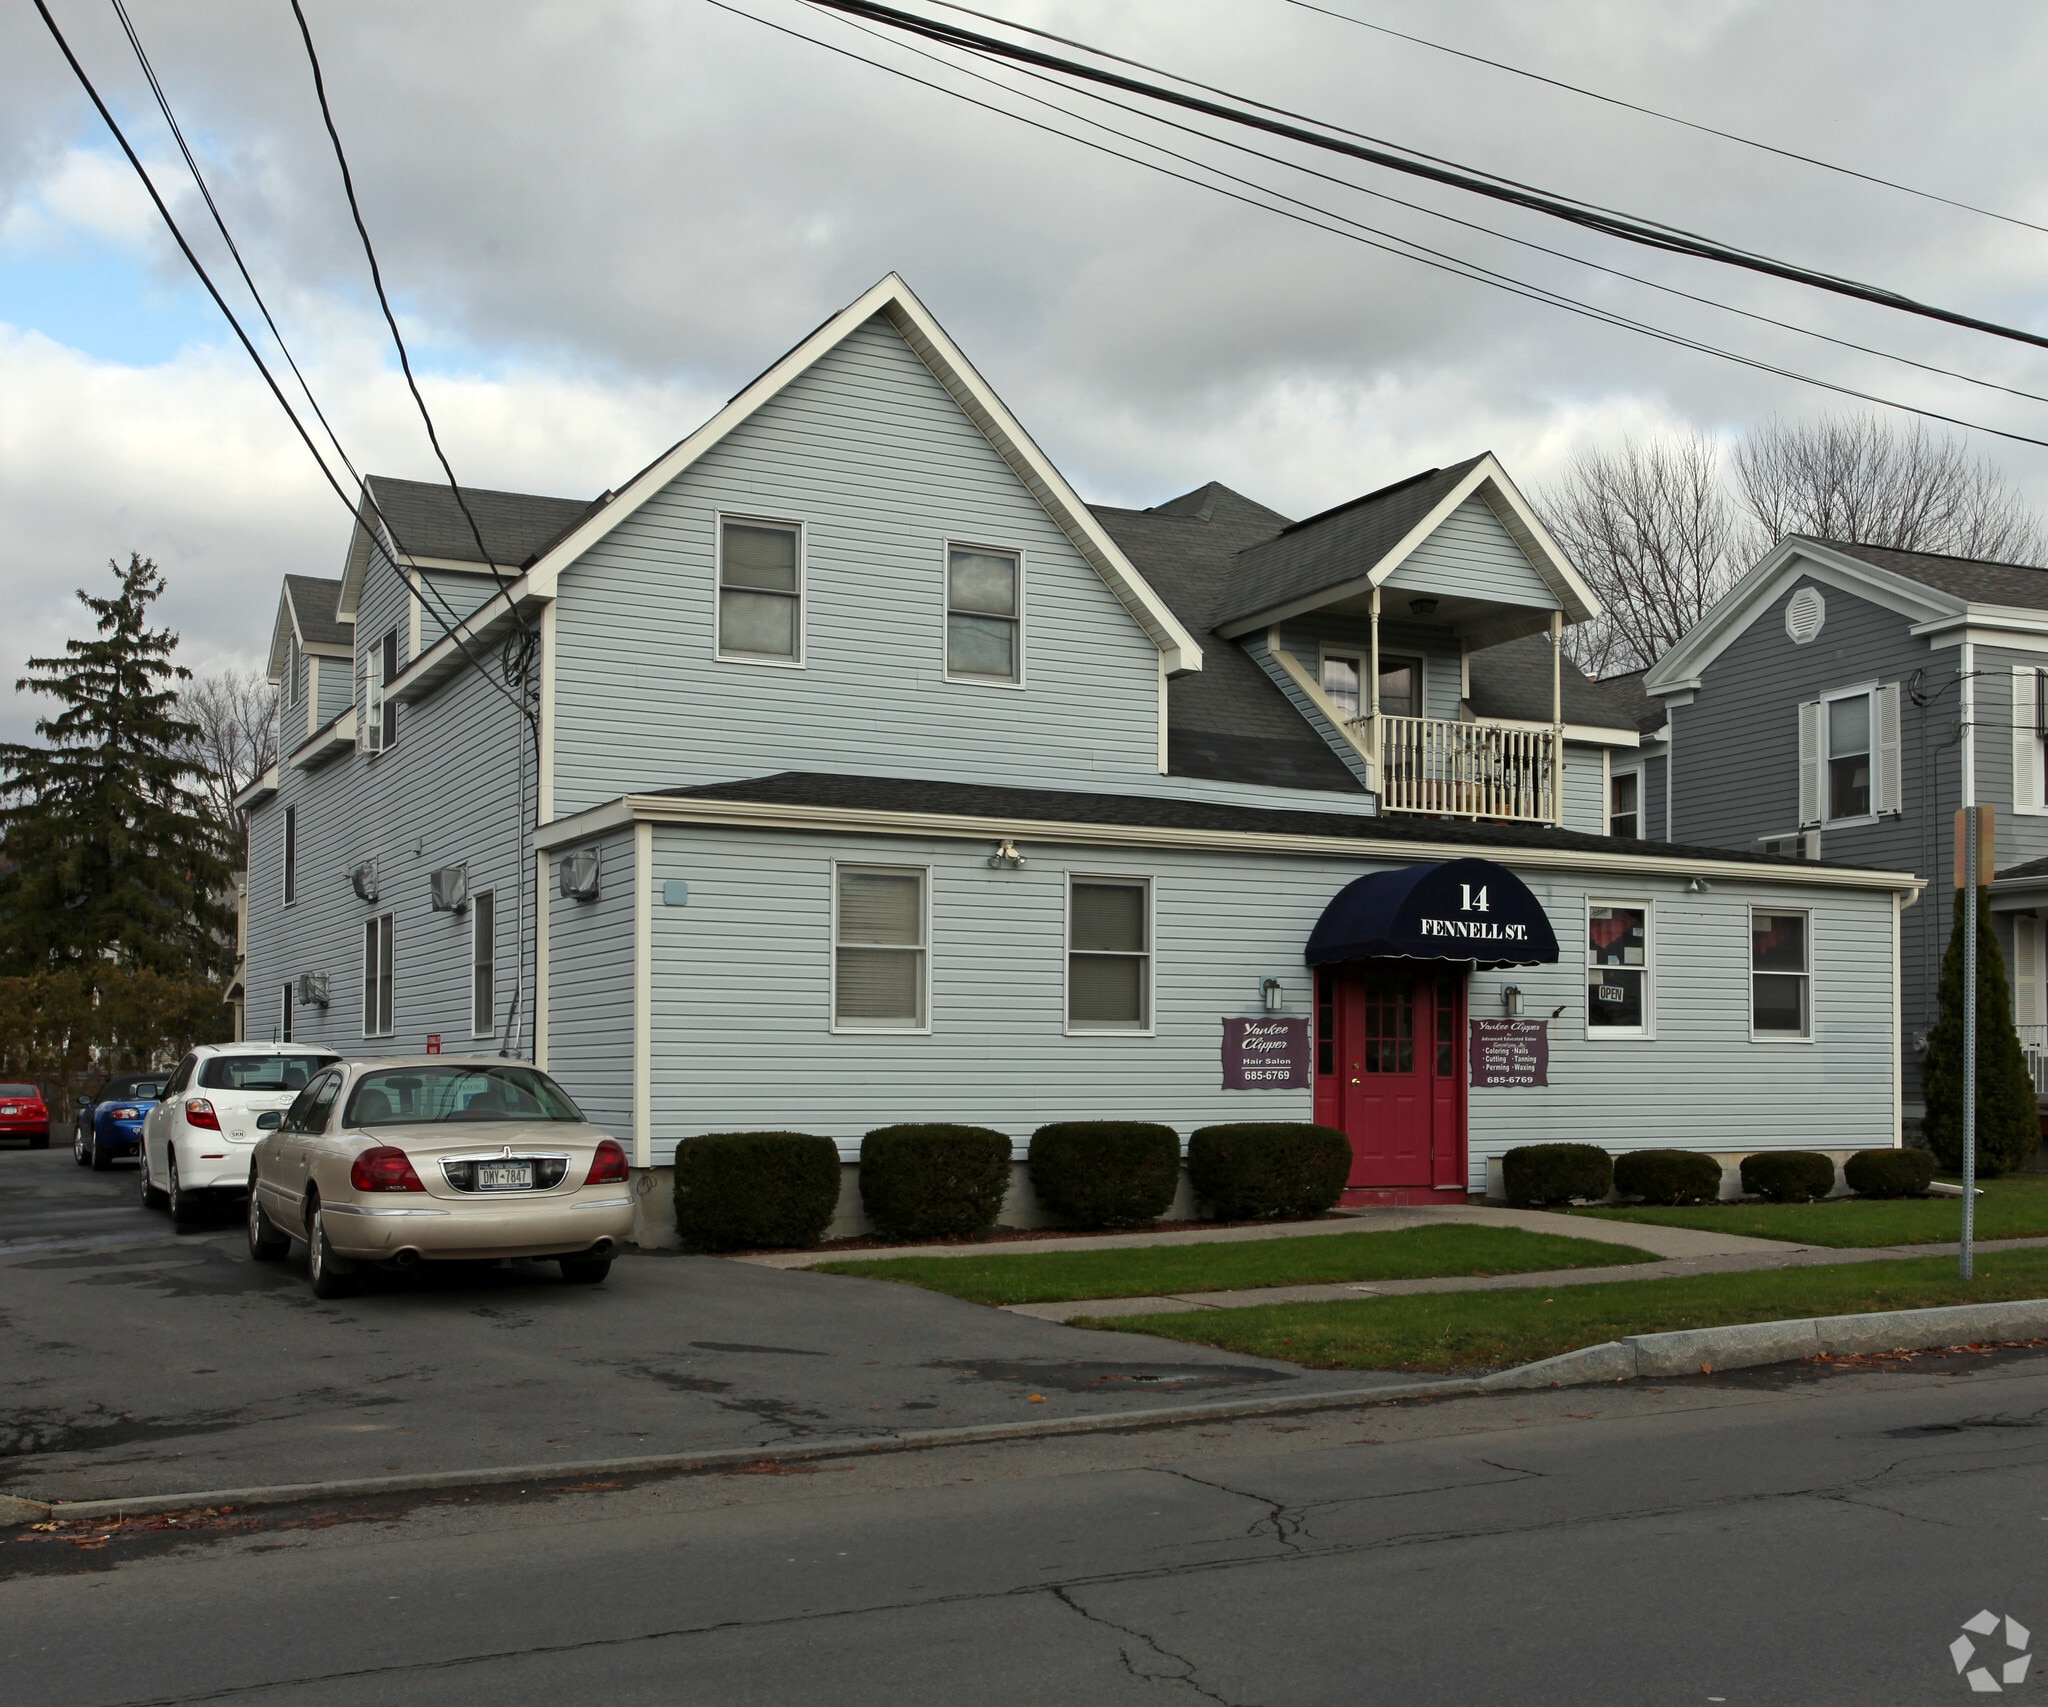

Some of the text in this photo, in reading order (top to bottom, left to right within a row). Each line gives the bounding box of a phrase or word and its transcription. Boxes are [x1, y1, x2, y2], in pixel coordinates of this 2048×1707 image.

[1460, 883, 1490, 912] 14
[1420, 918, 1528, 940] FENNELL ST.
[1600, 986, 1622, 1001] OPEN
[1243, 1023, 1289, 1035] Yankee
[1479, 1021, 1540, 1033] Yankee Clipper
[1241, 1037, 1287, 1053] Clipper
[1485, 1047, 1509, 1055] Coloring
[1485, 1055, 1506, 1063] Cutting
[1514, 1055, 1537, 1063] Tanning
[1485, 1063, 1510, 1072] Perming
[1514, 1063, 1536, 1072] Waxing
[1244, 1070, 1290, 1080] 685-6769
[1487, 1076, 1533, 1084] 685-6769
